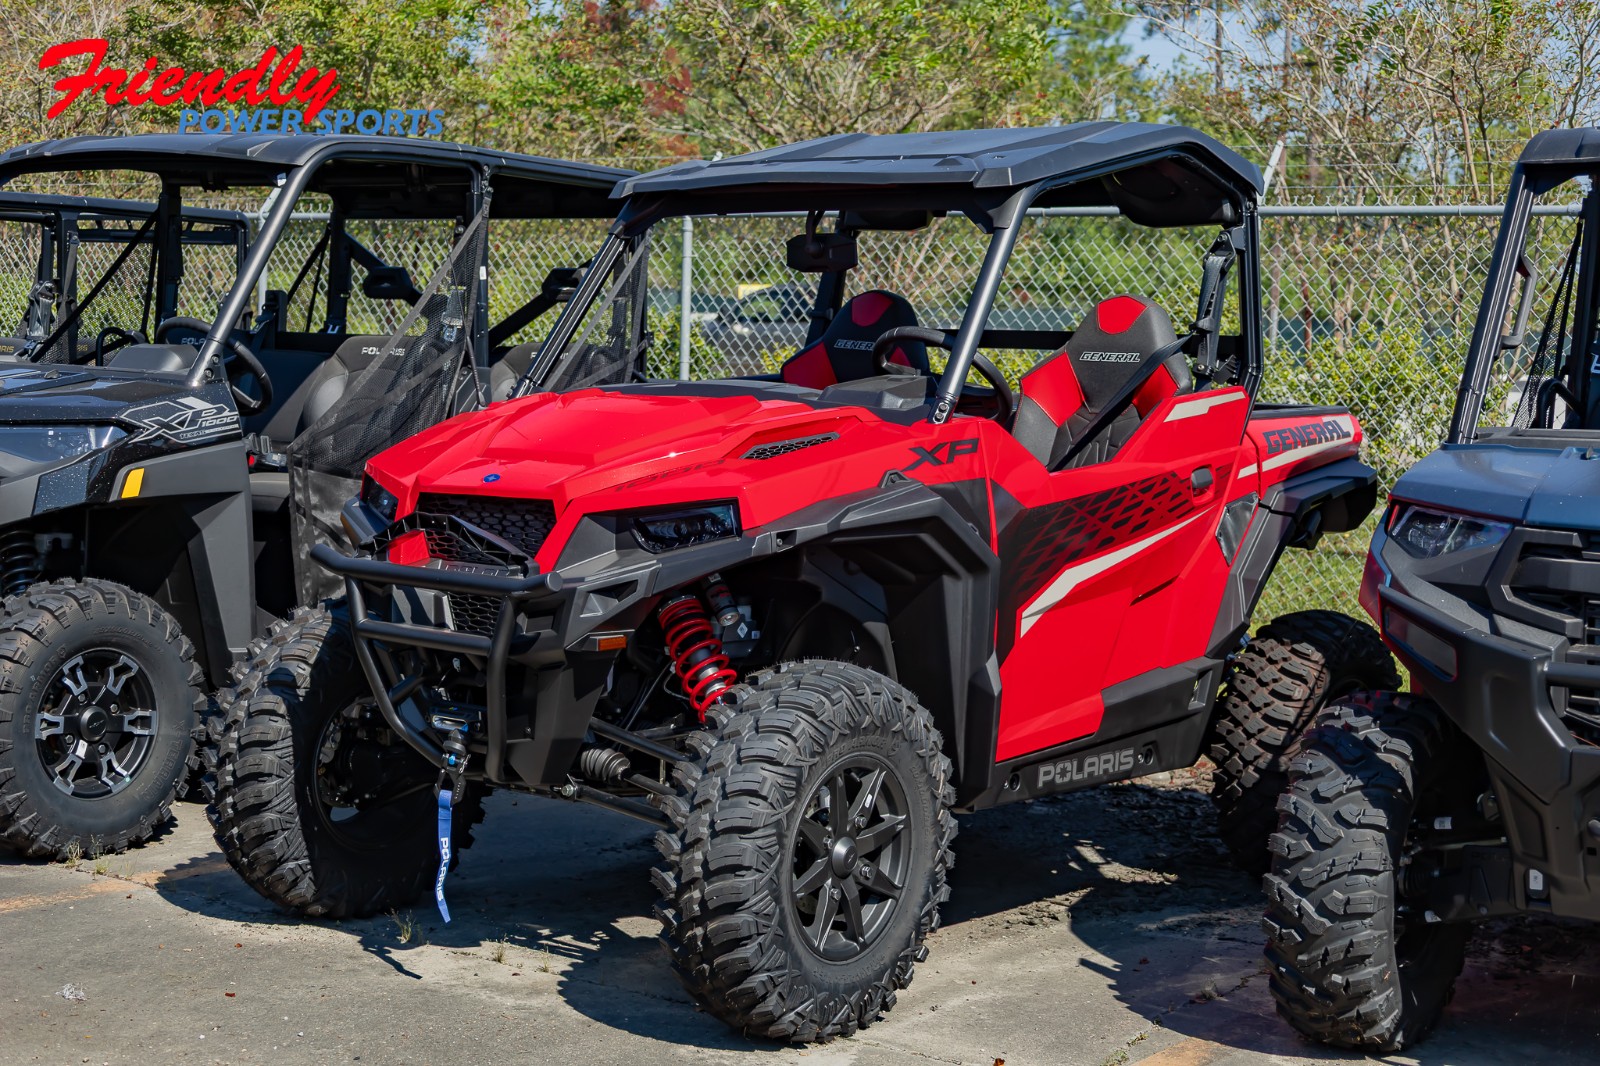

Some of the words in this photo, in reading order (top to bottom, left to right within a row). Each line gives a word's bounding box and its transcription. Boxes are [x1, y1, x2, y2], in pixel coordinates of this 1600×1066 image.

[361, 346, 405, 356] POLRIS
[833, 339, 876, 351] GENER
[1079, 351, 1141, 362] GENERAL
[202, 416, 239, 428] 1000
[1263, 420, 1352, 454] GENERAL
[900, 438, 980, 472] XP
[1037, 748, 1134, 788] POLARIS
[437, 837, 450, 901] POLARIS
